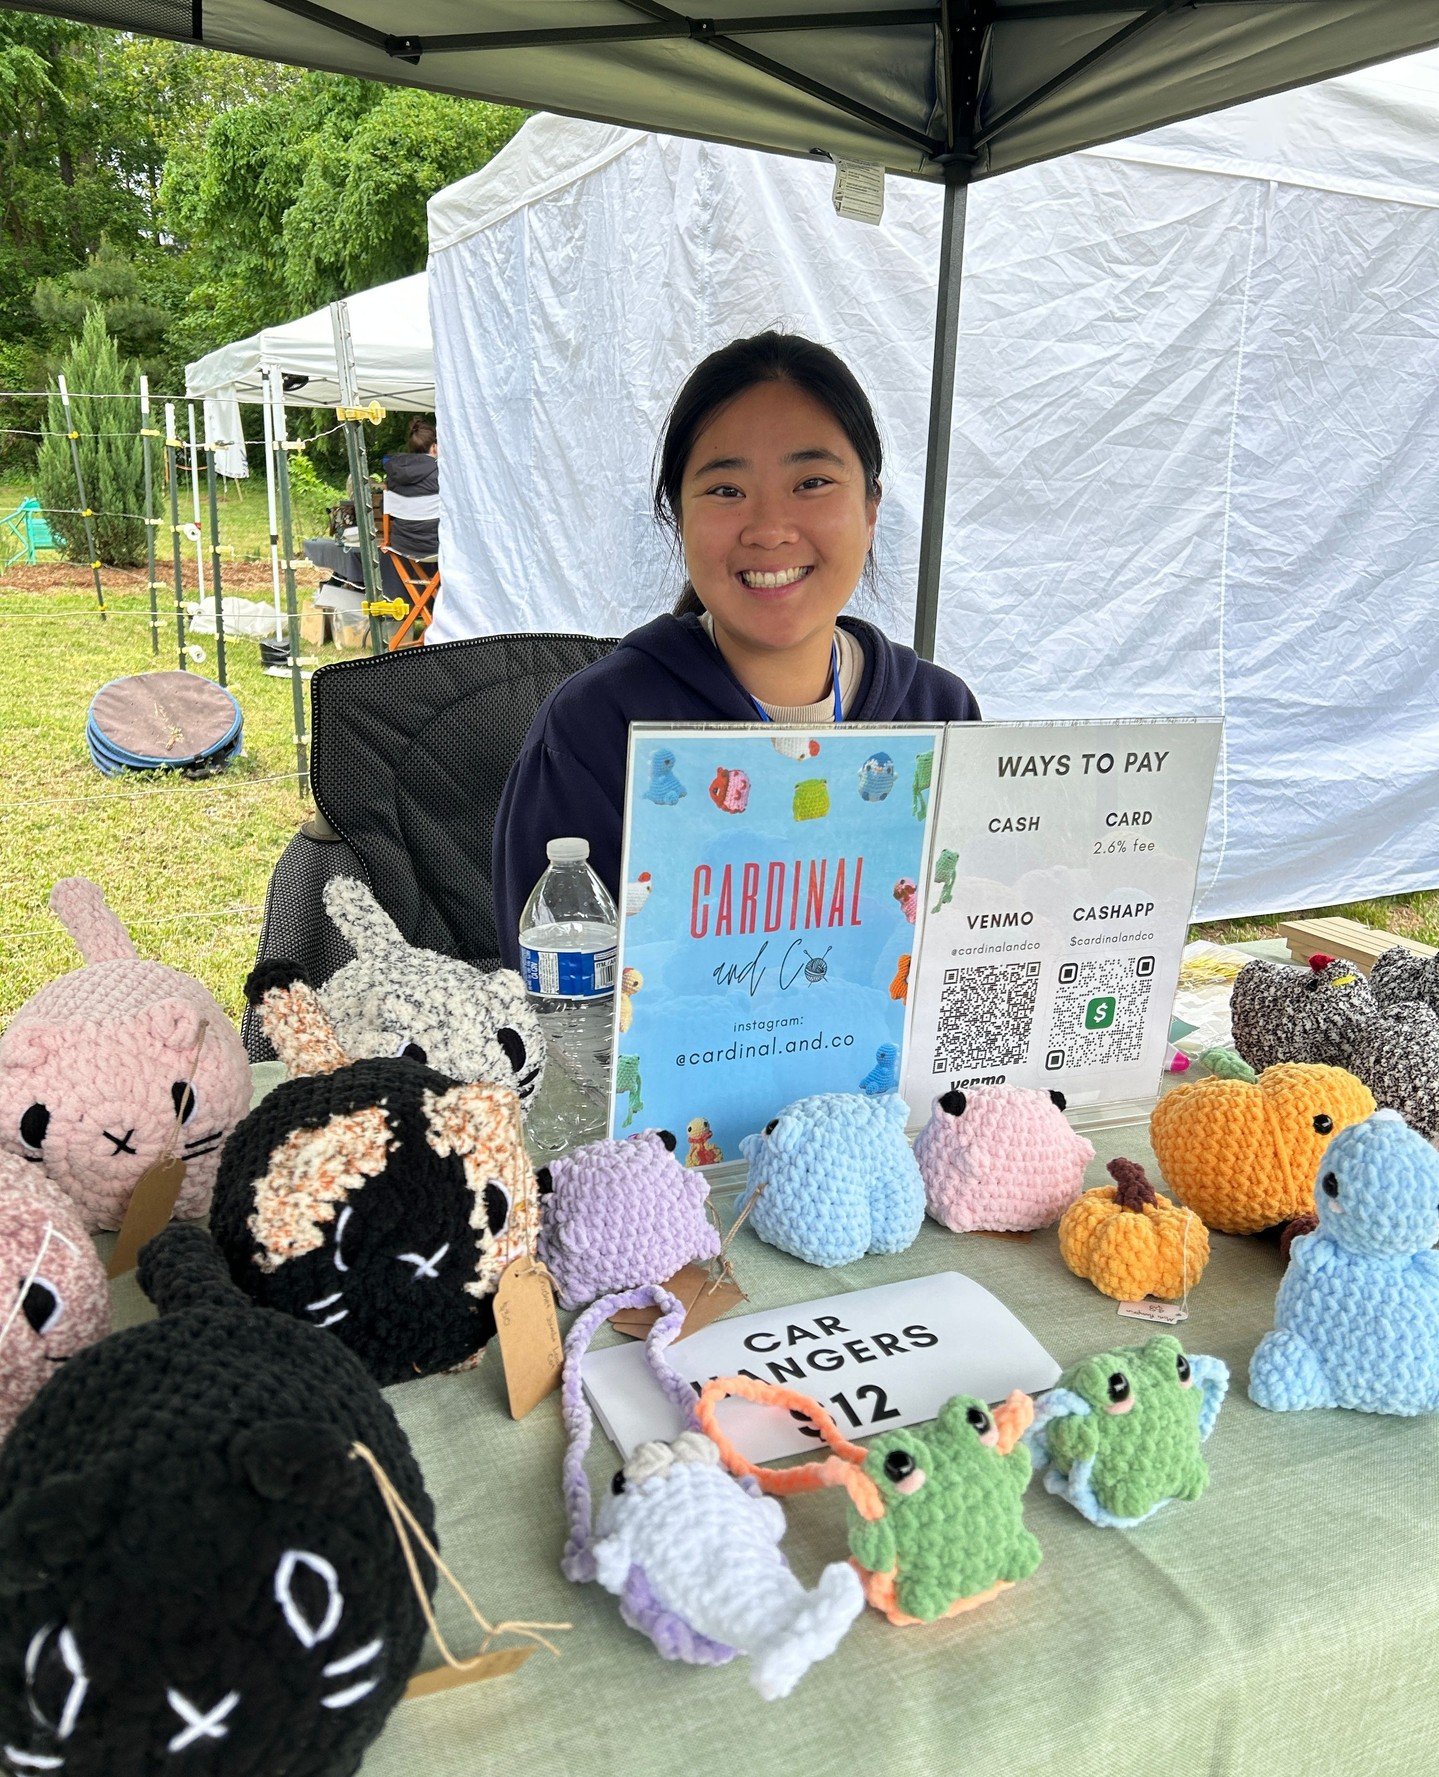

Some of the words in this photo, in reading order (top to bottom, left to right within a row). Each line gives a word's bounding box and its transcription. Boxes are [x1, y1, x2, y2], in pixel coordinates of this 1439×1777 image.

[998, 754, 1071, 778] WAYS
[1081, 753, 1115, 775] TO
[1124, 751, 1170, 773] PAY
[988, 816, 1041, 833] CASH
[1105, 811, 1153, 827] CARD
[1093, 840, 1127, 855] 2.6%
[1133, 838, 1155, 852] fee
[690, 857, 864, 939] CARDINAL
[967, 911, 1034, 930] VENMO
[1073, 902, 1155, 922] CASHAPP
[951, 939, 1040, 956] @cardinalandco
[1070, 930, 1154, 947] $cardinalandco
[713, 940, 769, 997] and
[733, 1016, 804, 1032] instagram:
[676, 1031, 854, 1067] @cardinal.and.co
[950, 1074, 1006, 1091] venmo
[743, 1315, 851, 1353] CAR
